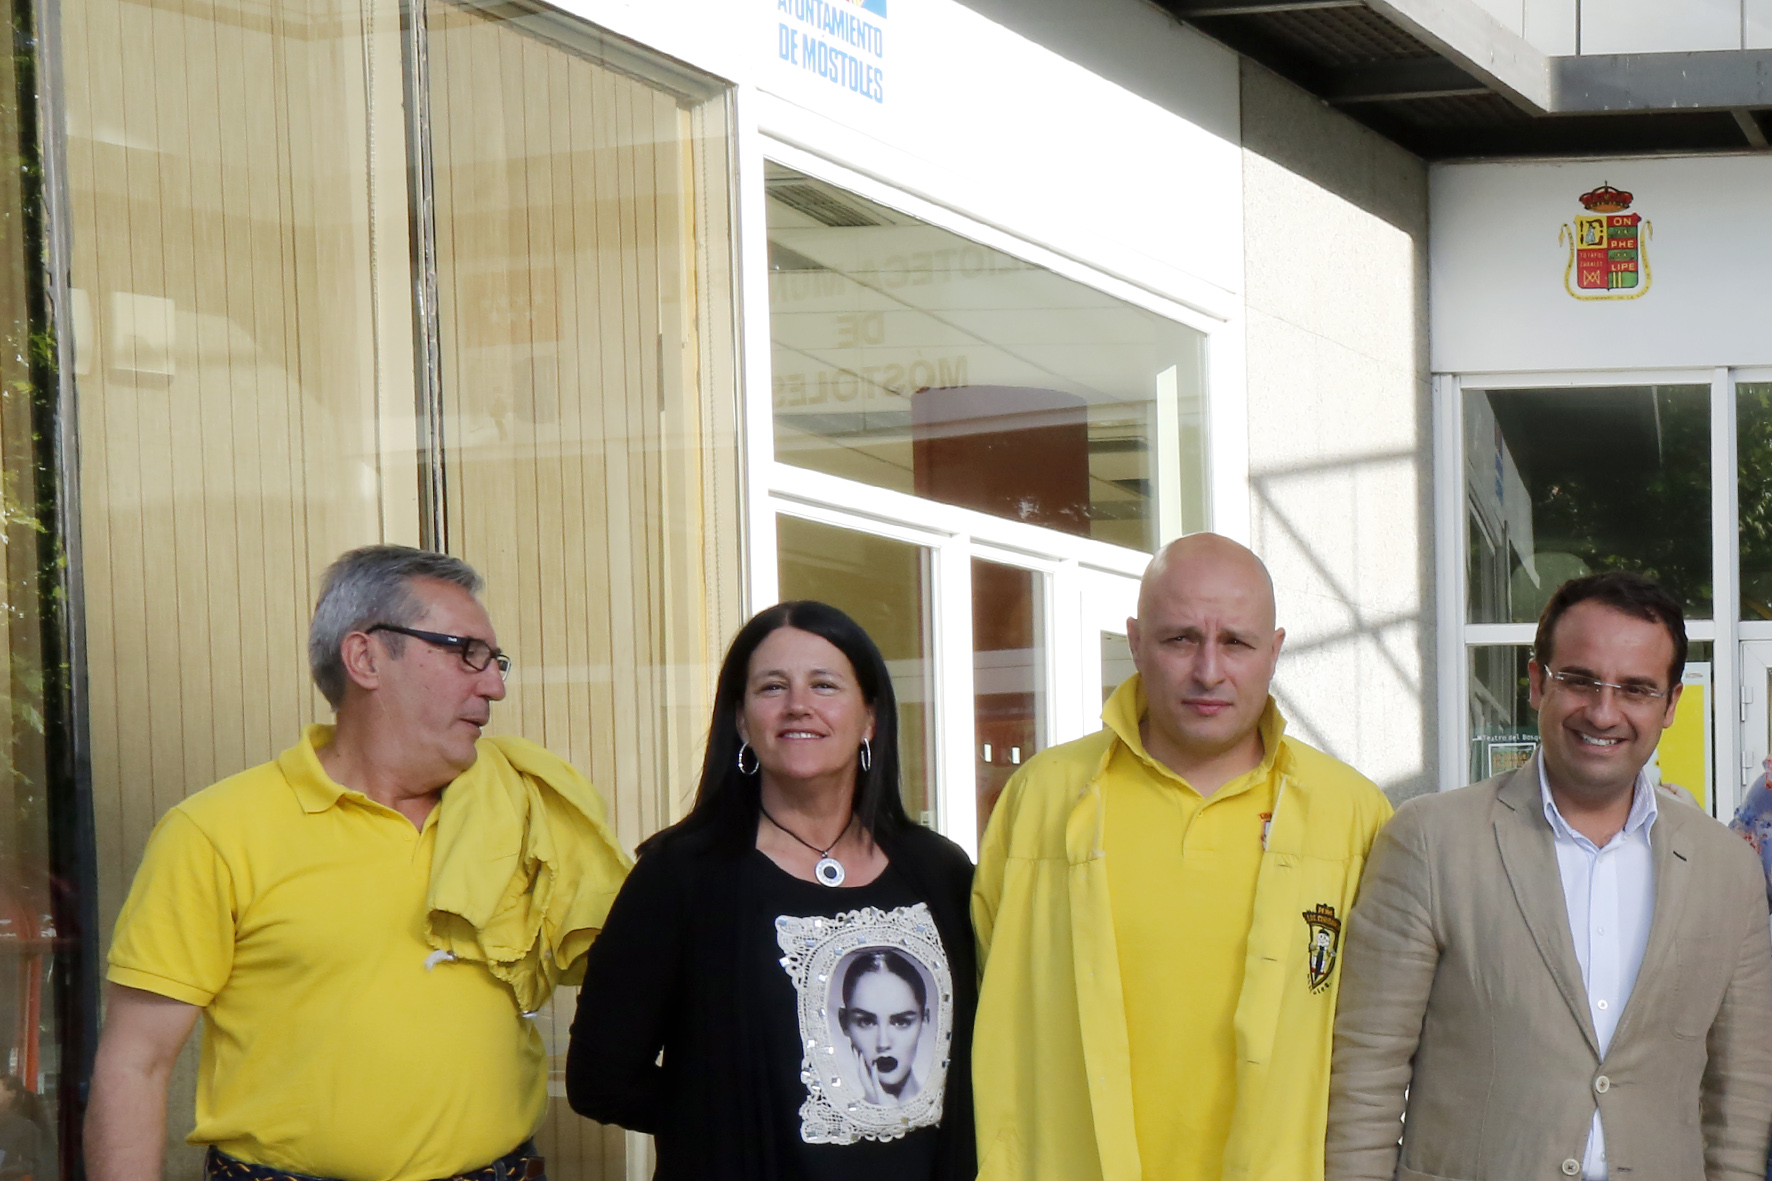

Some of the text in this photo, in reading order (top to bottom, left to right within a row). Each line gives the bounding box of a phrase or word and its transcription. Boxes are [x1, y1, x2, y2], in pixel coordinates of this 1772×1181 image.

[777, 0, 883, 58] UNTAMIENTO
[779, 22, 798, 66] DE
[1613, 217, 1632, 226] ON
[1611, 240, 1634, 249] PHE
[1611, 263, 1636, 271] LIPE
